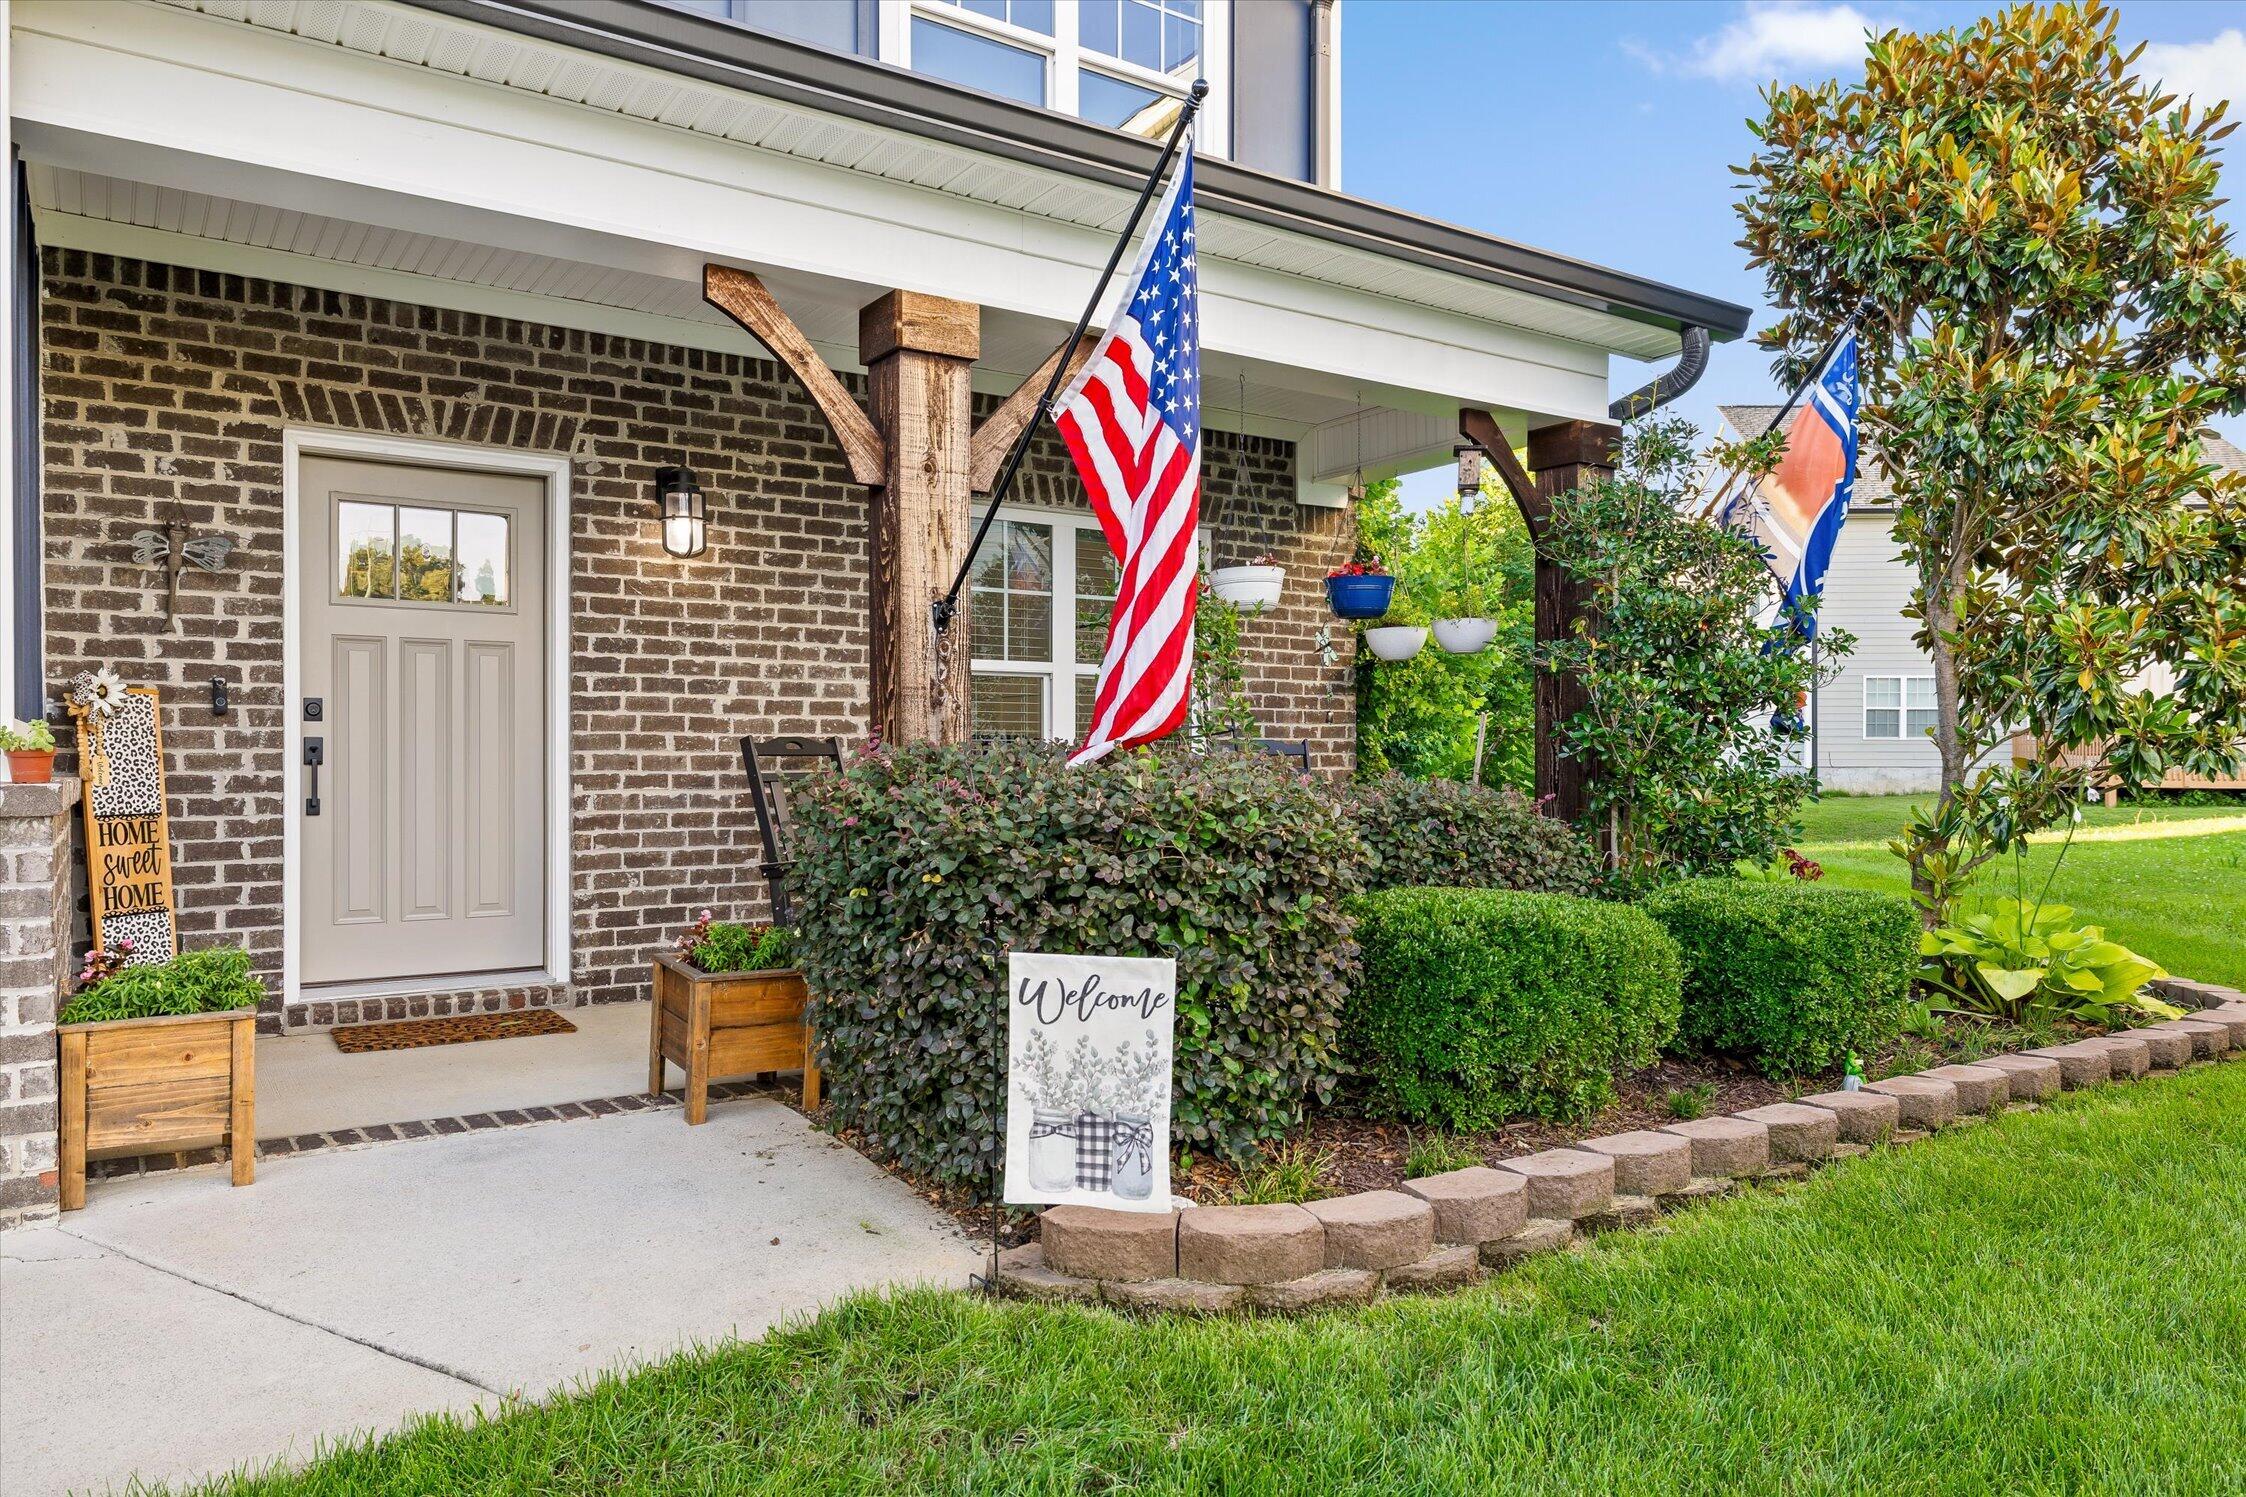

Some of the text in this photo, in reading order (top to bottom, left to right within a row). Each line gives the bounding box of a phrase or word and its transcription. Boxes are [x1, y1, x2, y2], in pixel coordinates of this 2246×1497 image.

[98, 821, 160, 846] HOME
[103, 844, 162, 885] sweet
[103, 882, 165, 910] HOME
[1018, 974, 1169, 1025] Welcome
